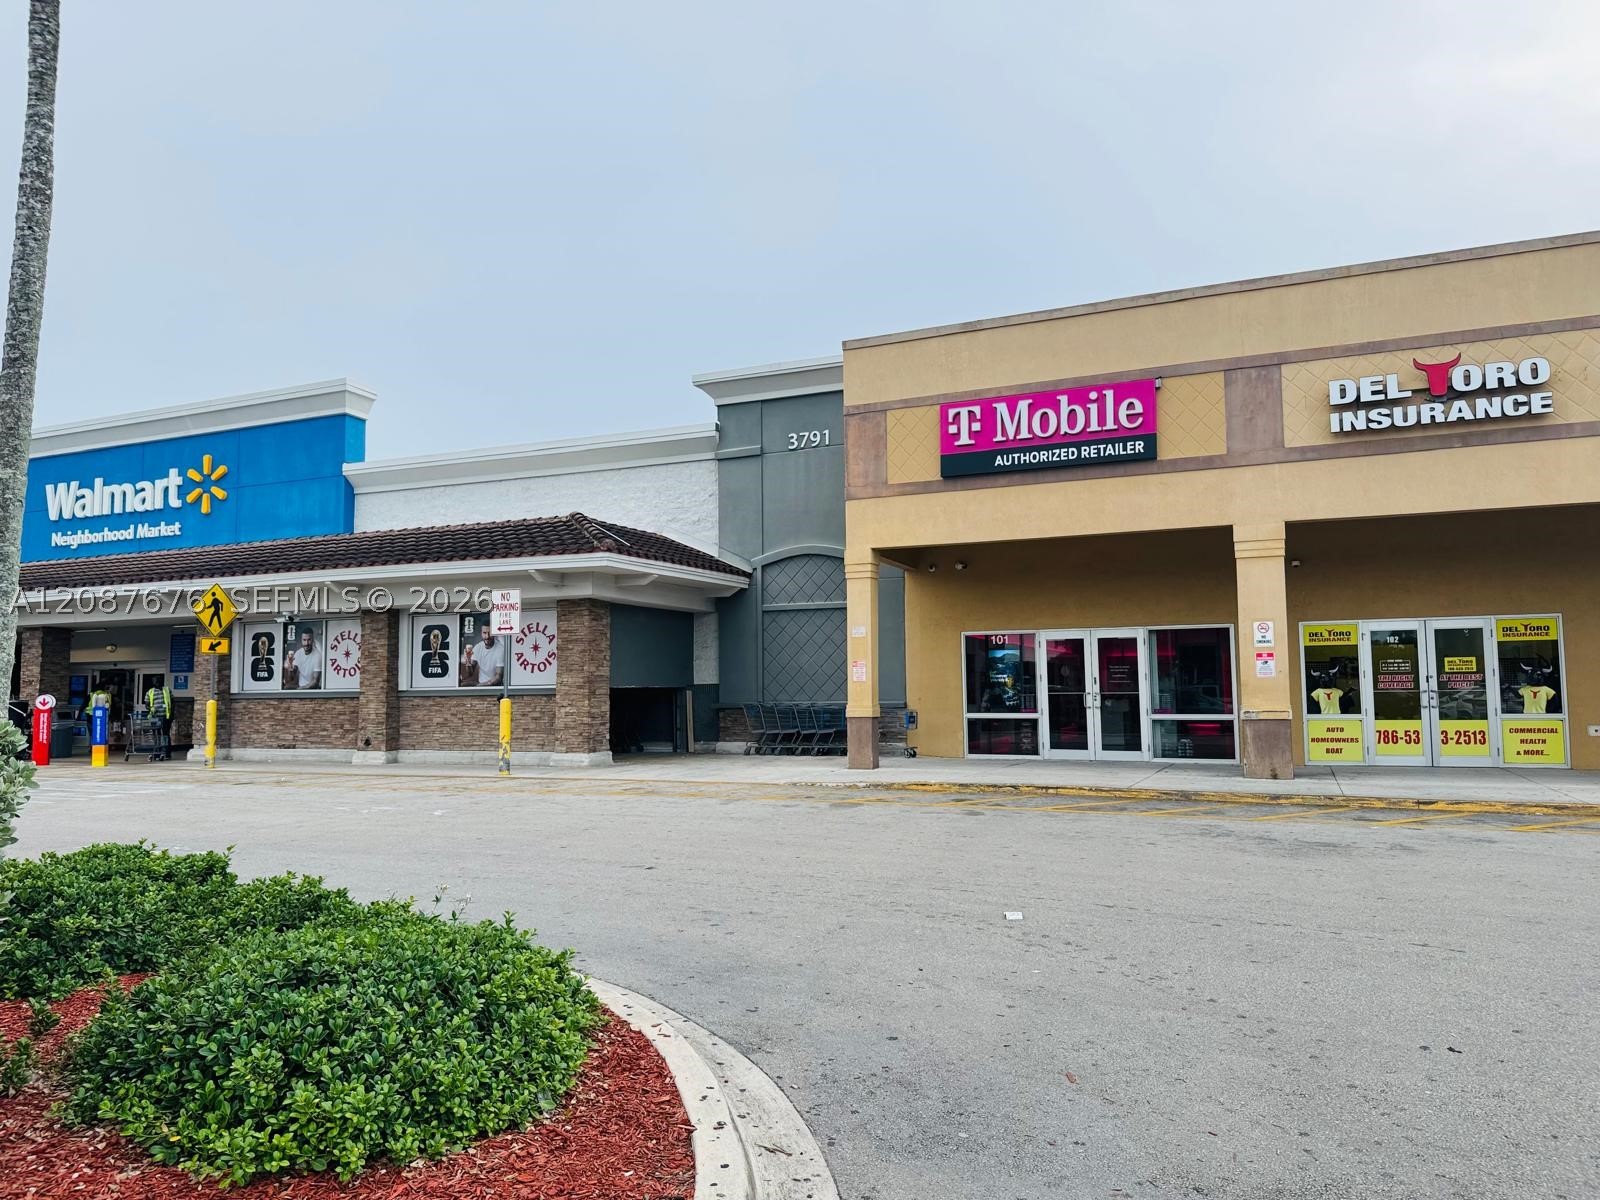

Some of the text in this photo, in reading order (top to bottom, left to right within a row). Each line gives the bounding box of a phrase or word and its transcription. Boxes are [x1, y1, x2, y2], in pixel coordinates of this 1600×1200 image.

[1328, 352, 1551, 406] DEL TORO
[947, 389, 1144, 446] T Mobile
[1329, 391, 1554, 433] INSURANCE
[788, 429, 830, 450] 3791
[994, 440, 1145, 467] AUTHORIZED RETAILER
[45, 468, 183, 521] Walmart
[51, 521, 182, 549] Neighborhood Market
[493, 602, 519, 612] PARKING
[501, 592, 511, 602] NO
[515, 622, 556, 645] STELLA
[1324, 628, 1352, 638] TORO
[1520, 622, 1550, 632] TORO
[990, 635, 1009, 645] 101
[515, 648, 557, 674] ARTOIS
[1441, 730, 1487, 745] 3-2513
